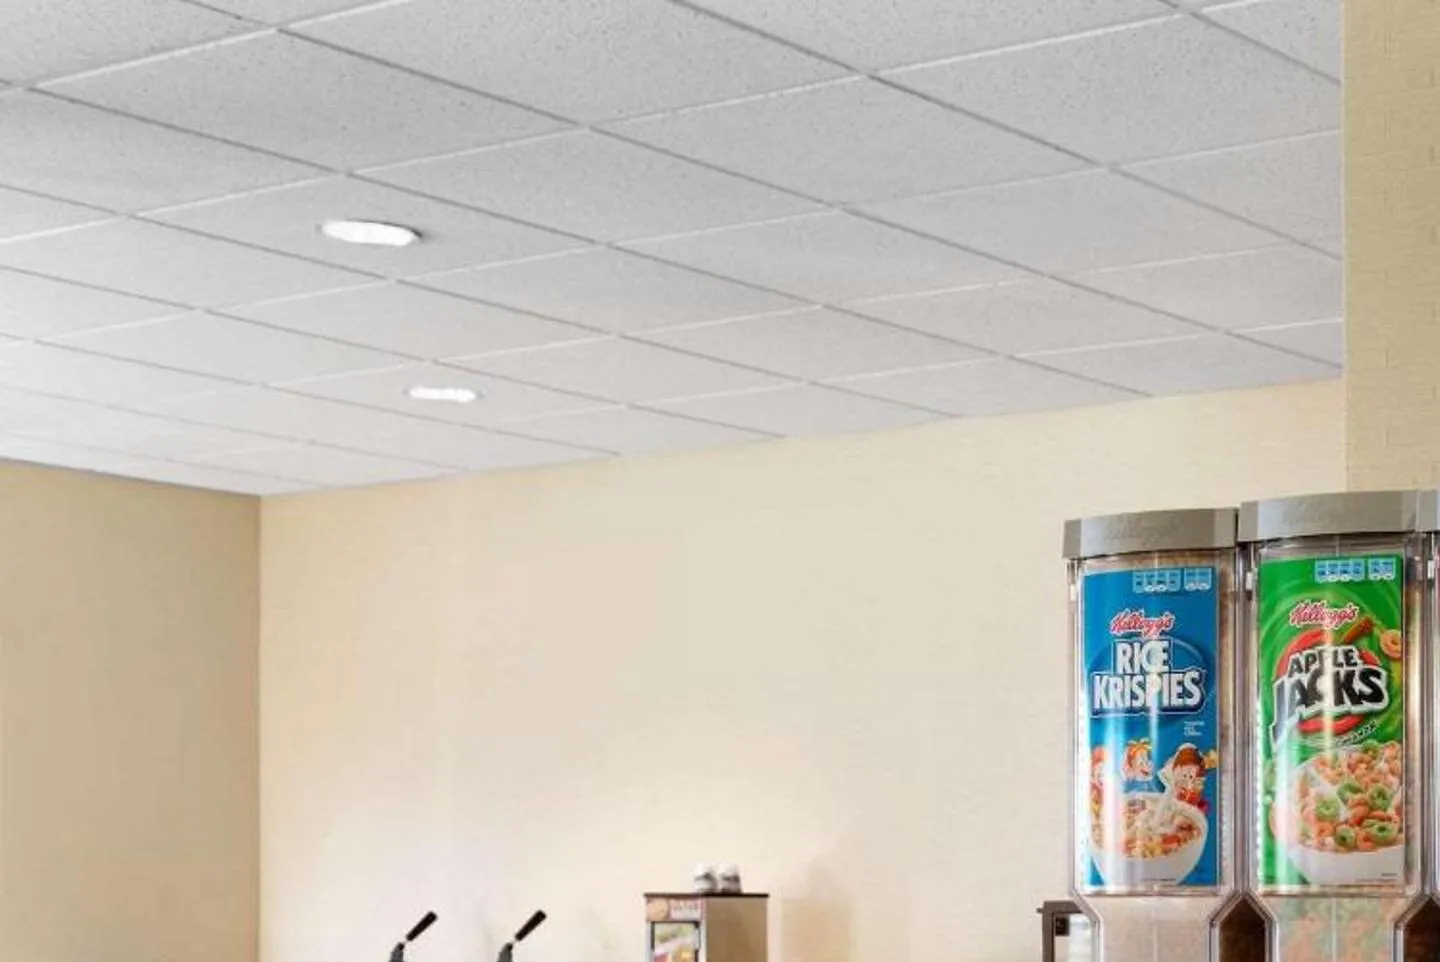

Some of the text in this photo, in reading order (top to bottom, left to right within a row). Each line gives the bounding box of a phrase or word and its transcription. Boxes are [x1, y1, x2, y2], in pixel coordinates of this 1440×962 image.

[1111, 608, 1176, 640] Kellogg's
[1290, 601, 1359, 630] Kellogg's
[1116, 640, 1170, 674] RICE
[1094, 670, 1201, 709] KRISPIES
